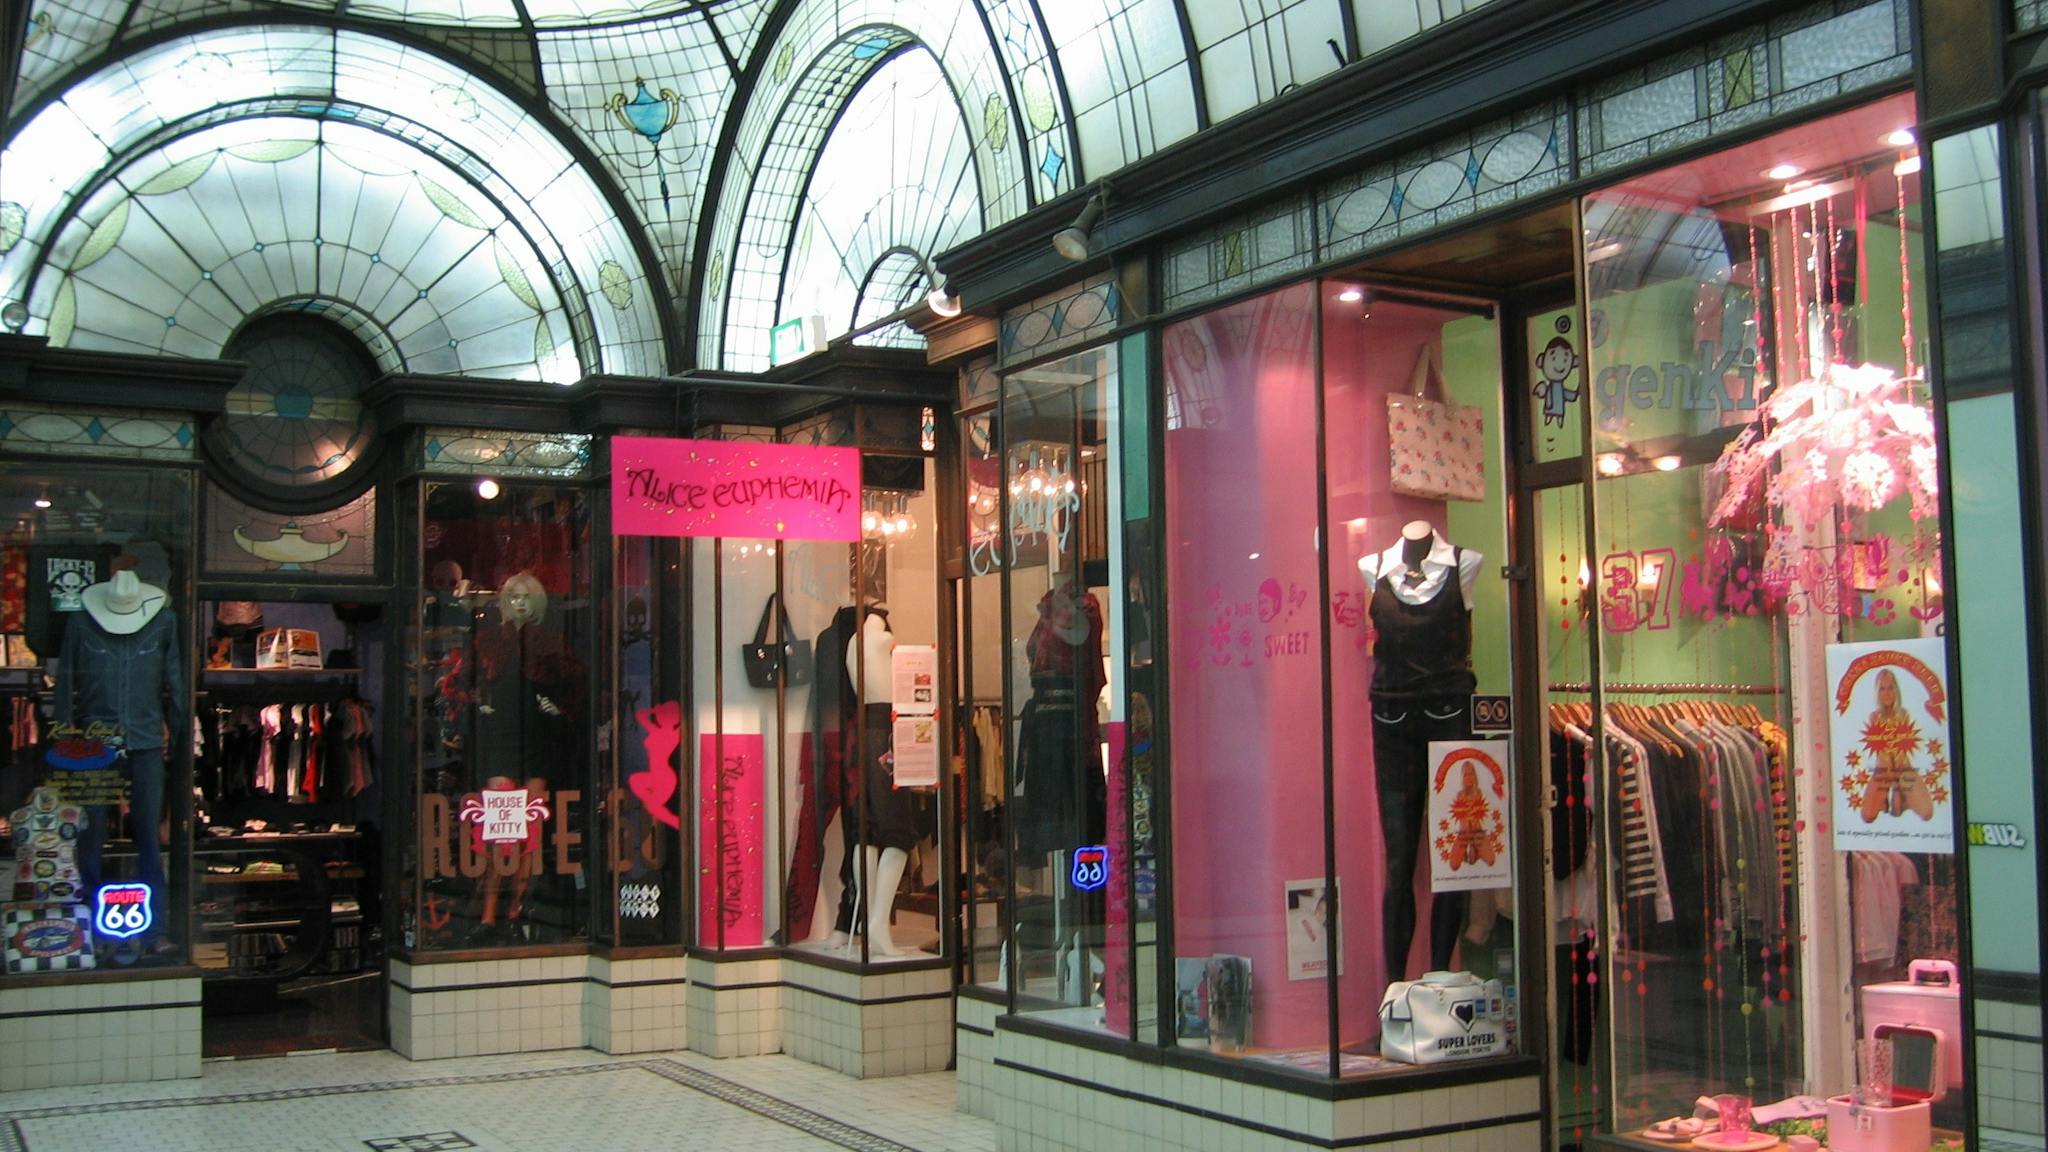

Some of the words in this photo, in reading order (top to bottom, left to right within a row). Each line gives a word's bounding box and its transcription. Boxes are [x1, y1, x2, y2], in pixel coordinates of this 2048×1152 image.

[1602, 547, 1676, 632] 37
[1265, 632, 1309, 658] SWEET
[487, 796, 523, 809] HOUSE
[499, 809, 512, 821] OF
[489, 822, 522, 834] KITTY
[103, 890, 146, 904] ROUTE
[105, 903, 144, 929] 66
[1438, 1036, 1465, 1049] SUPER
[1467, 1032, 1496, 1047] LOVERS
